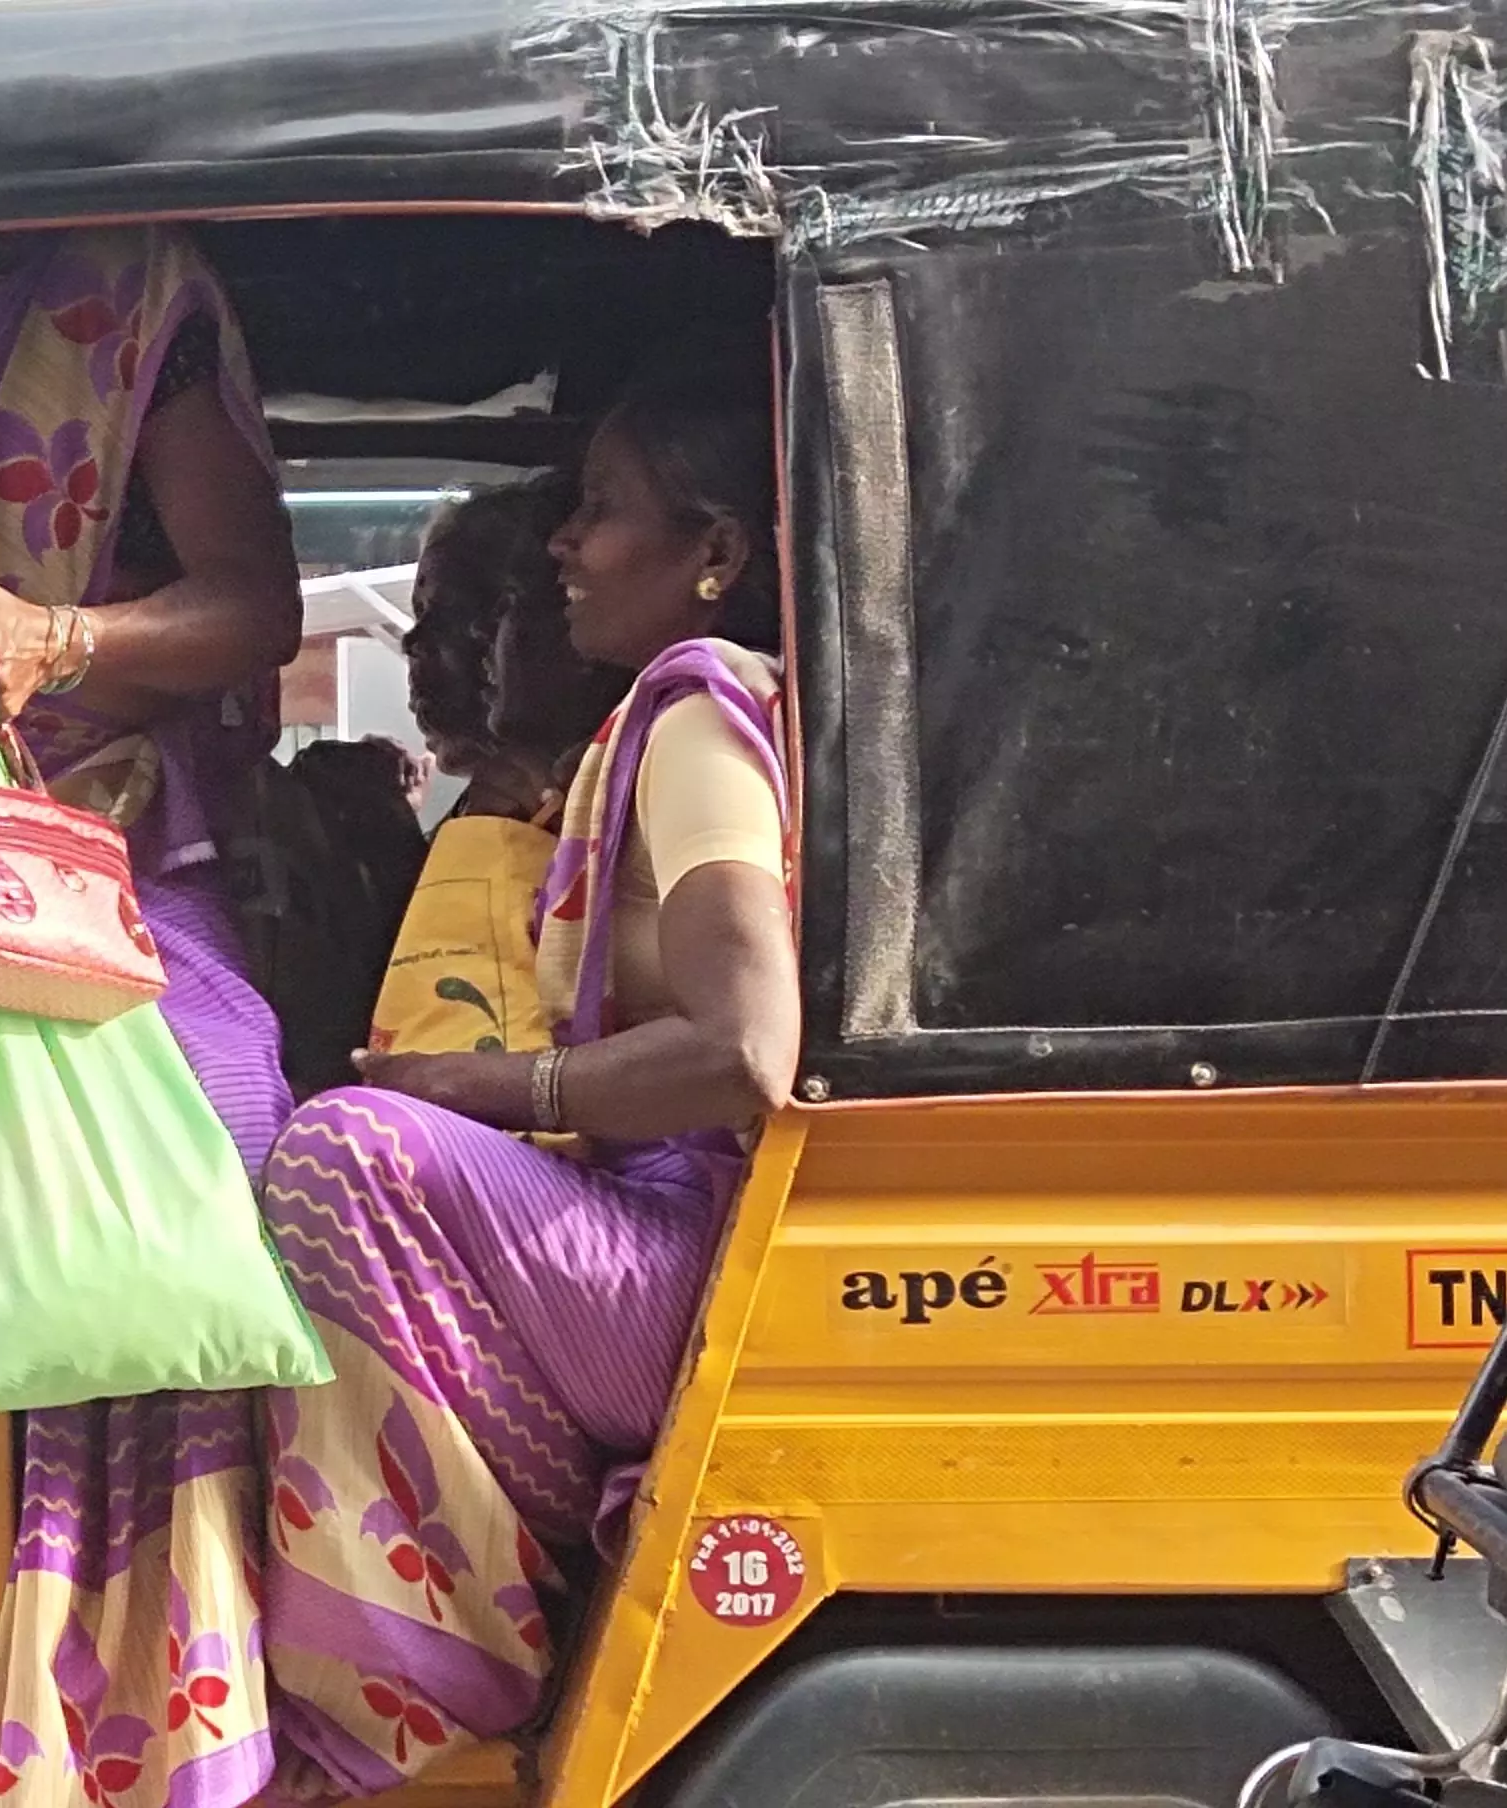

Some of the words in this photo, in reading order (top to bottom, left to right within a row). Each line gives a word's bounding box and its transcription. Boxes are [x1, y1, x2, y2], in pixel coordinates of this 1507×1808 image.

[1028, 1250, 1161, 1315] xtra
[1180, 1279, 1275, 1313] DLX
[690, 1533, 719, 1572] PER
[722, 1550, 769, 1586] 16
[715, 1591, 776, 1616] 2017
